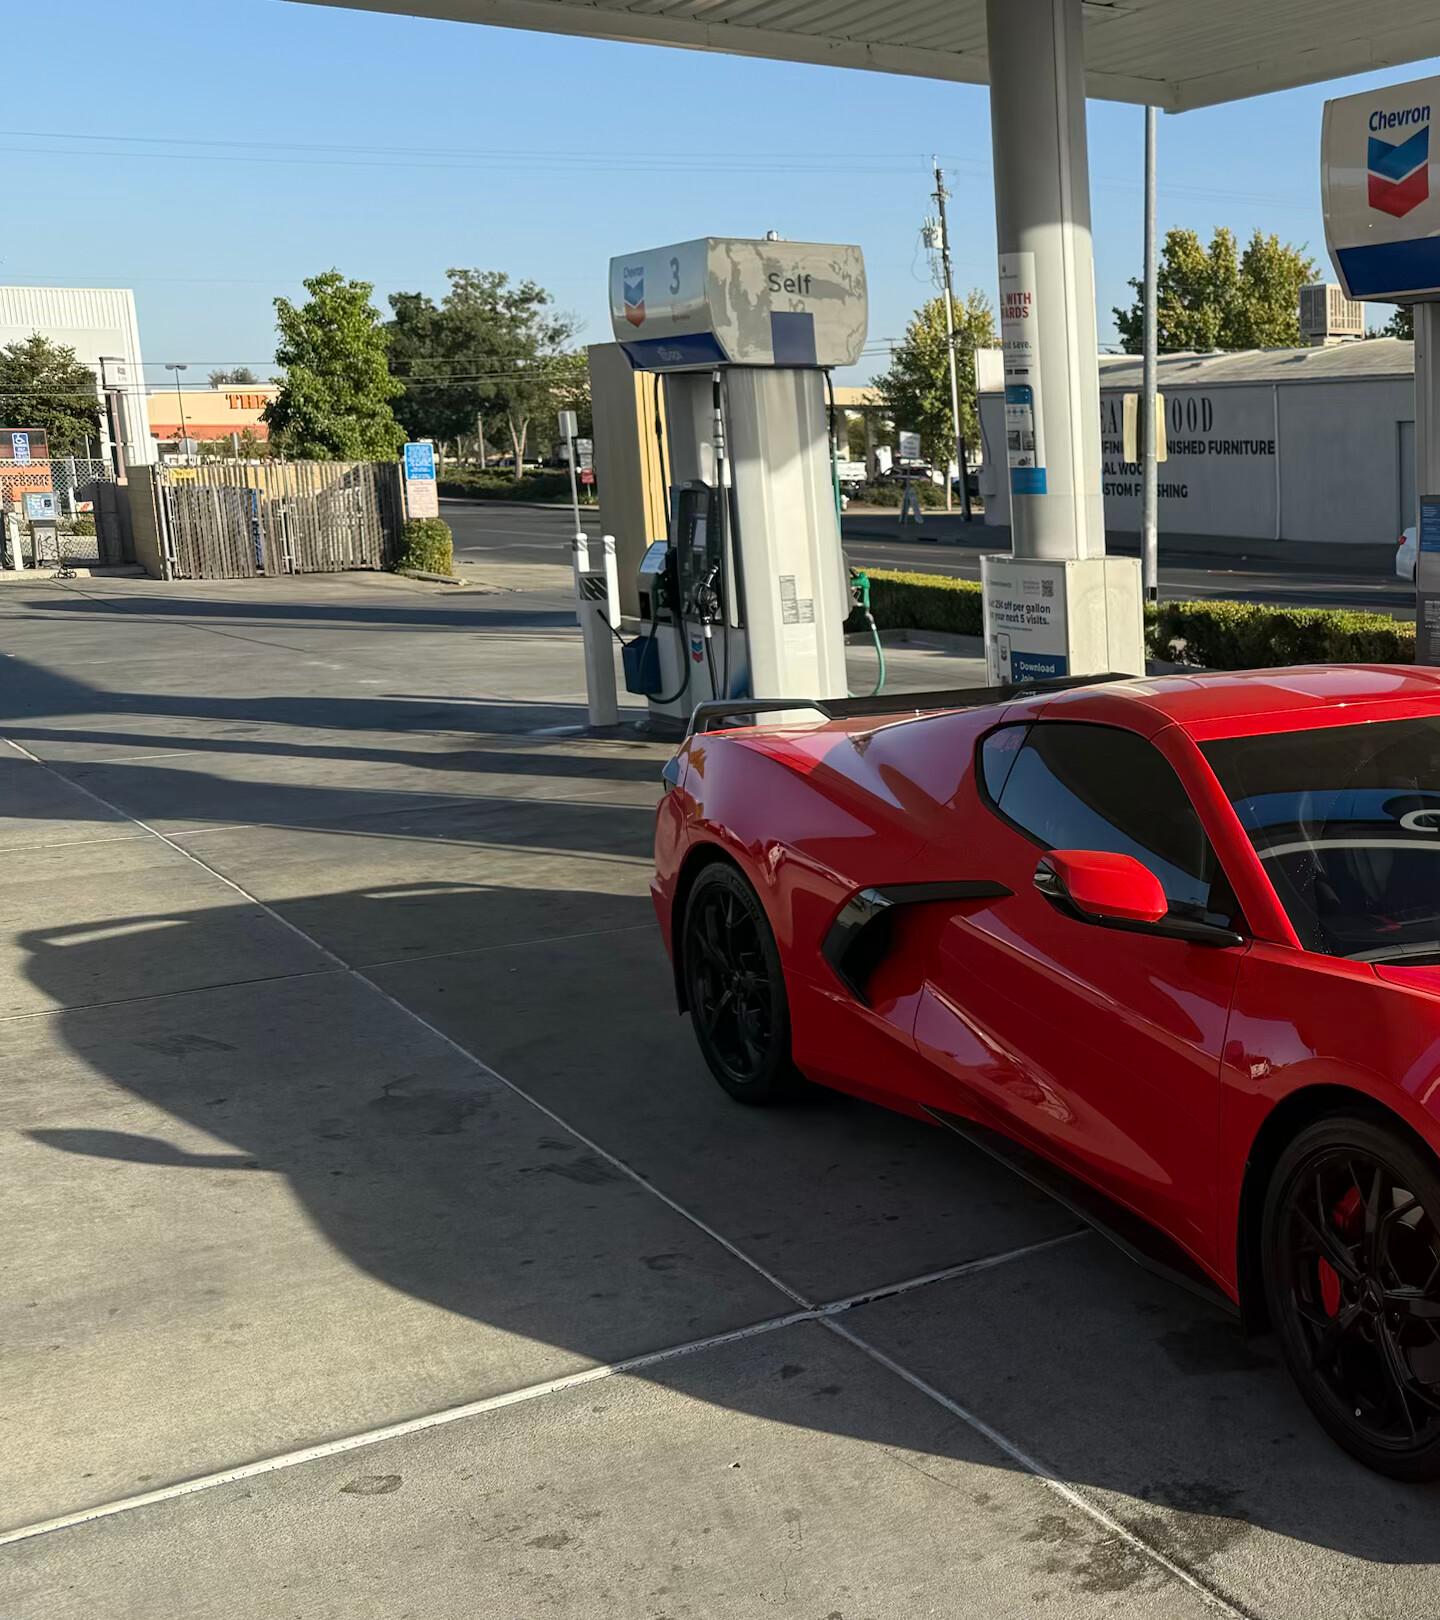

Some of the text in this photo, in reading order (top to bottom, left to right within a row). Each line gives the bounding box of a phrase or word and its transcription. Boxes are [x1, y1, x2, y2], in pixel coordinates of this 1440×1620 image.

[1368, 105, 1431, 131] Chevron
[669, 257, 680, 295] 3
[768, 272, 812, 295] Self
[1006, 292, 1032, 305] WITH
[1002, 306, 1029, 319] ARDS
[1208, 439, 1276, 456] FURNITURE
[1013, 603, 1025, 613] per
[1025, 603, 1051, 614] gallon
[1006, 613, 1019, 623] next
[1020, 614, 1026, 624] 5
[1019, 661, 1056, 673] Download
